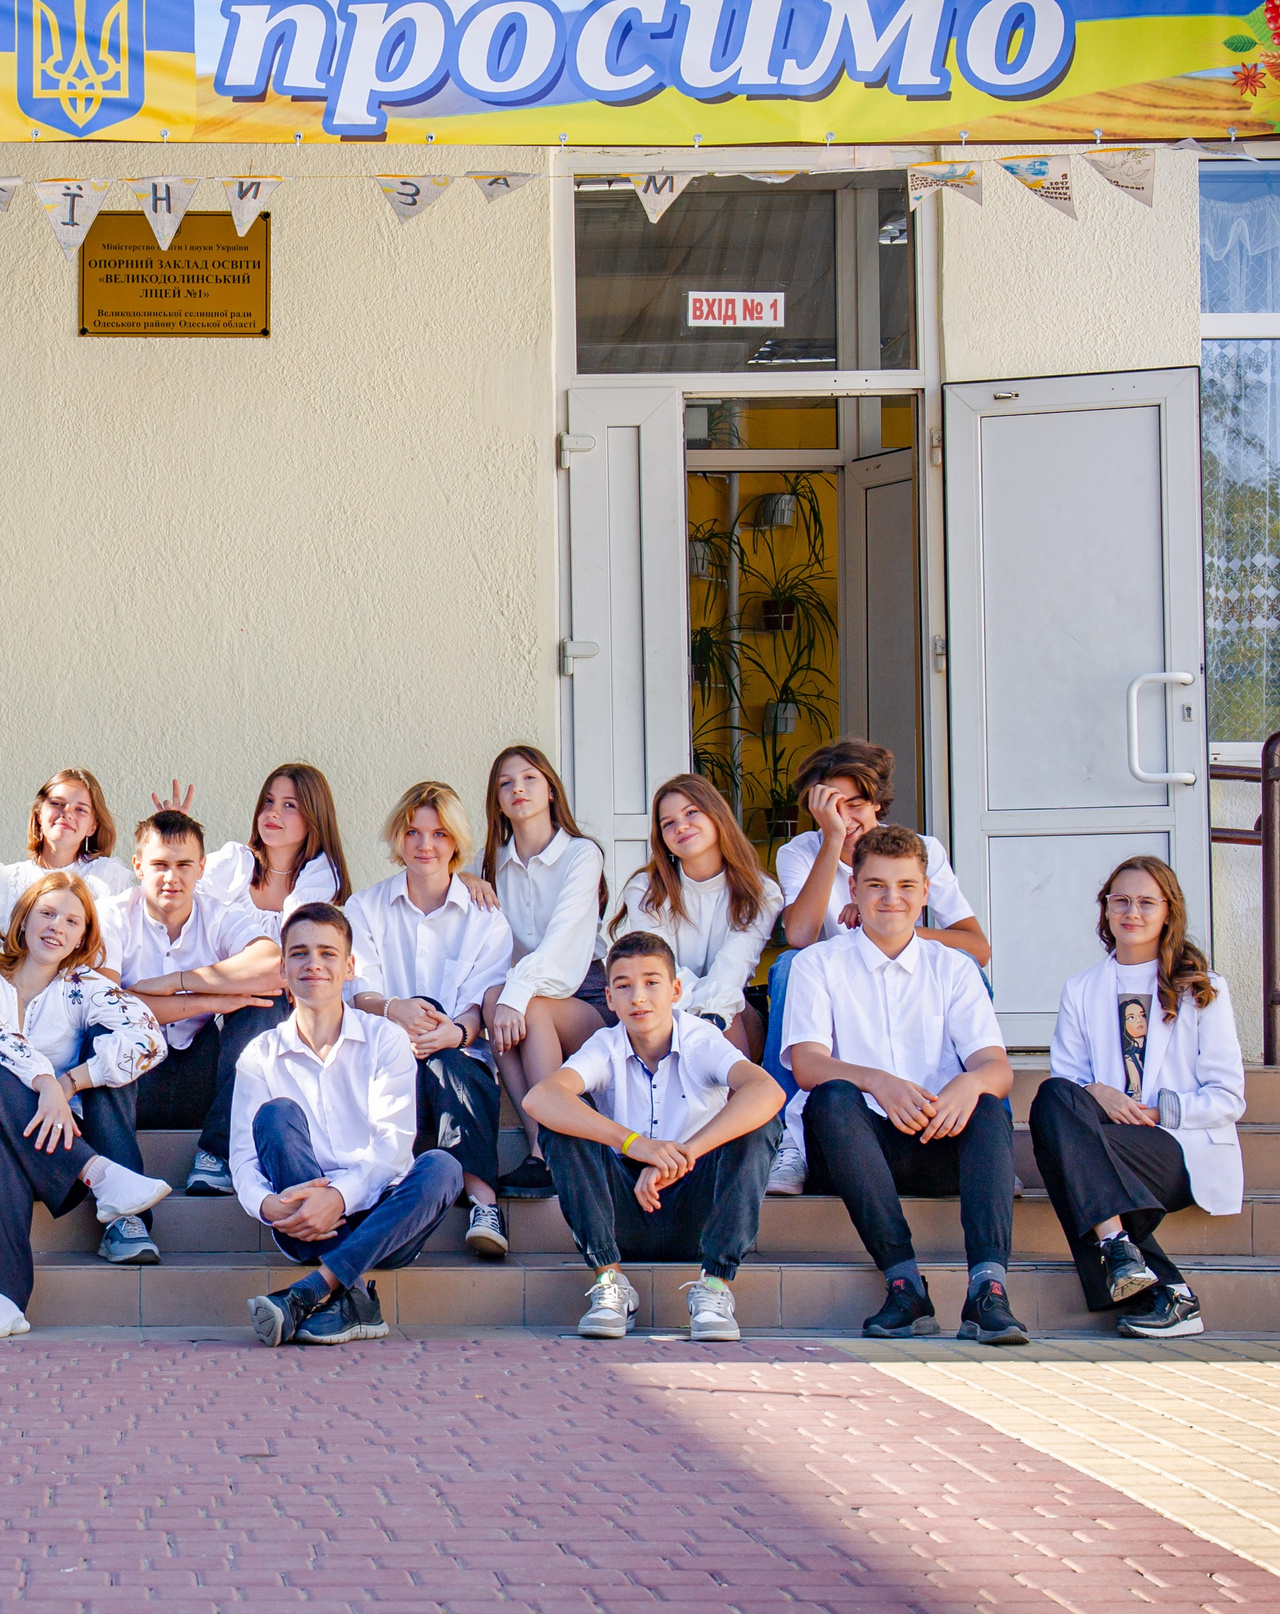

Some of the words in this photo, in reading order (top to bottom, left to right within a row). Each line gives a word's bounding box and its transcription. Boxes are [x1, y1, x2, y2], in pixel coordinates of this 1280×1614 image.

[216, 0, 1076, 138] просимо
[102, 243, 155, 252] Міністерство
[189, 245, 214, 253] науки
[215, 243, 249, 253] України
[88, 257, 154, 269] ОПОРНИЙ
[157, 259, 209, 271] ЗАКЛАД
[212, 259, 261, 269] ОСВІТИ
[99, 271, 251, 285] «ВЕЛИКОДОЛИНСЬКИЙ
[139, 286, 181, 299] ЛІЦЕЙ
[97, 308, 182, 318] Великодолинської
[184, 309, 228, 318] селищної
[230, 311, 252, 319] ради
[692, 298, 737, 325] ВХІД
[742, 298, 763, 321] №
[769, 298, 778, 321] 1
[93, 319, 142, 328] Одеського
[144, 319, 176, 330] району
[179, 319, 220, 328] Одеської
[222, 319, 256, 328] області
